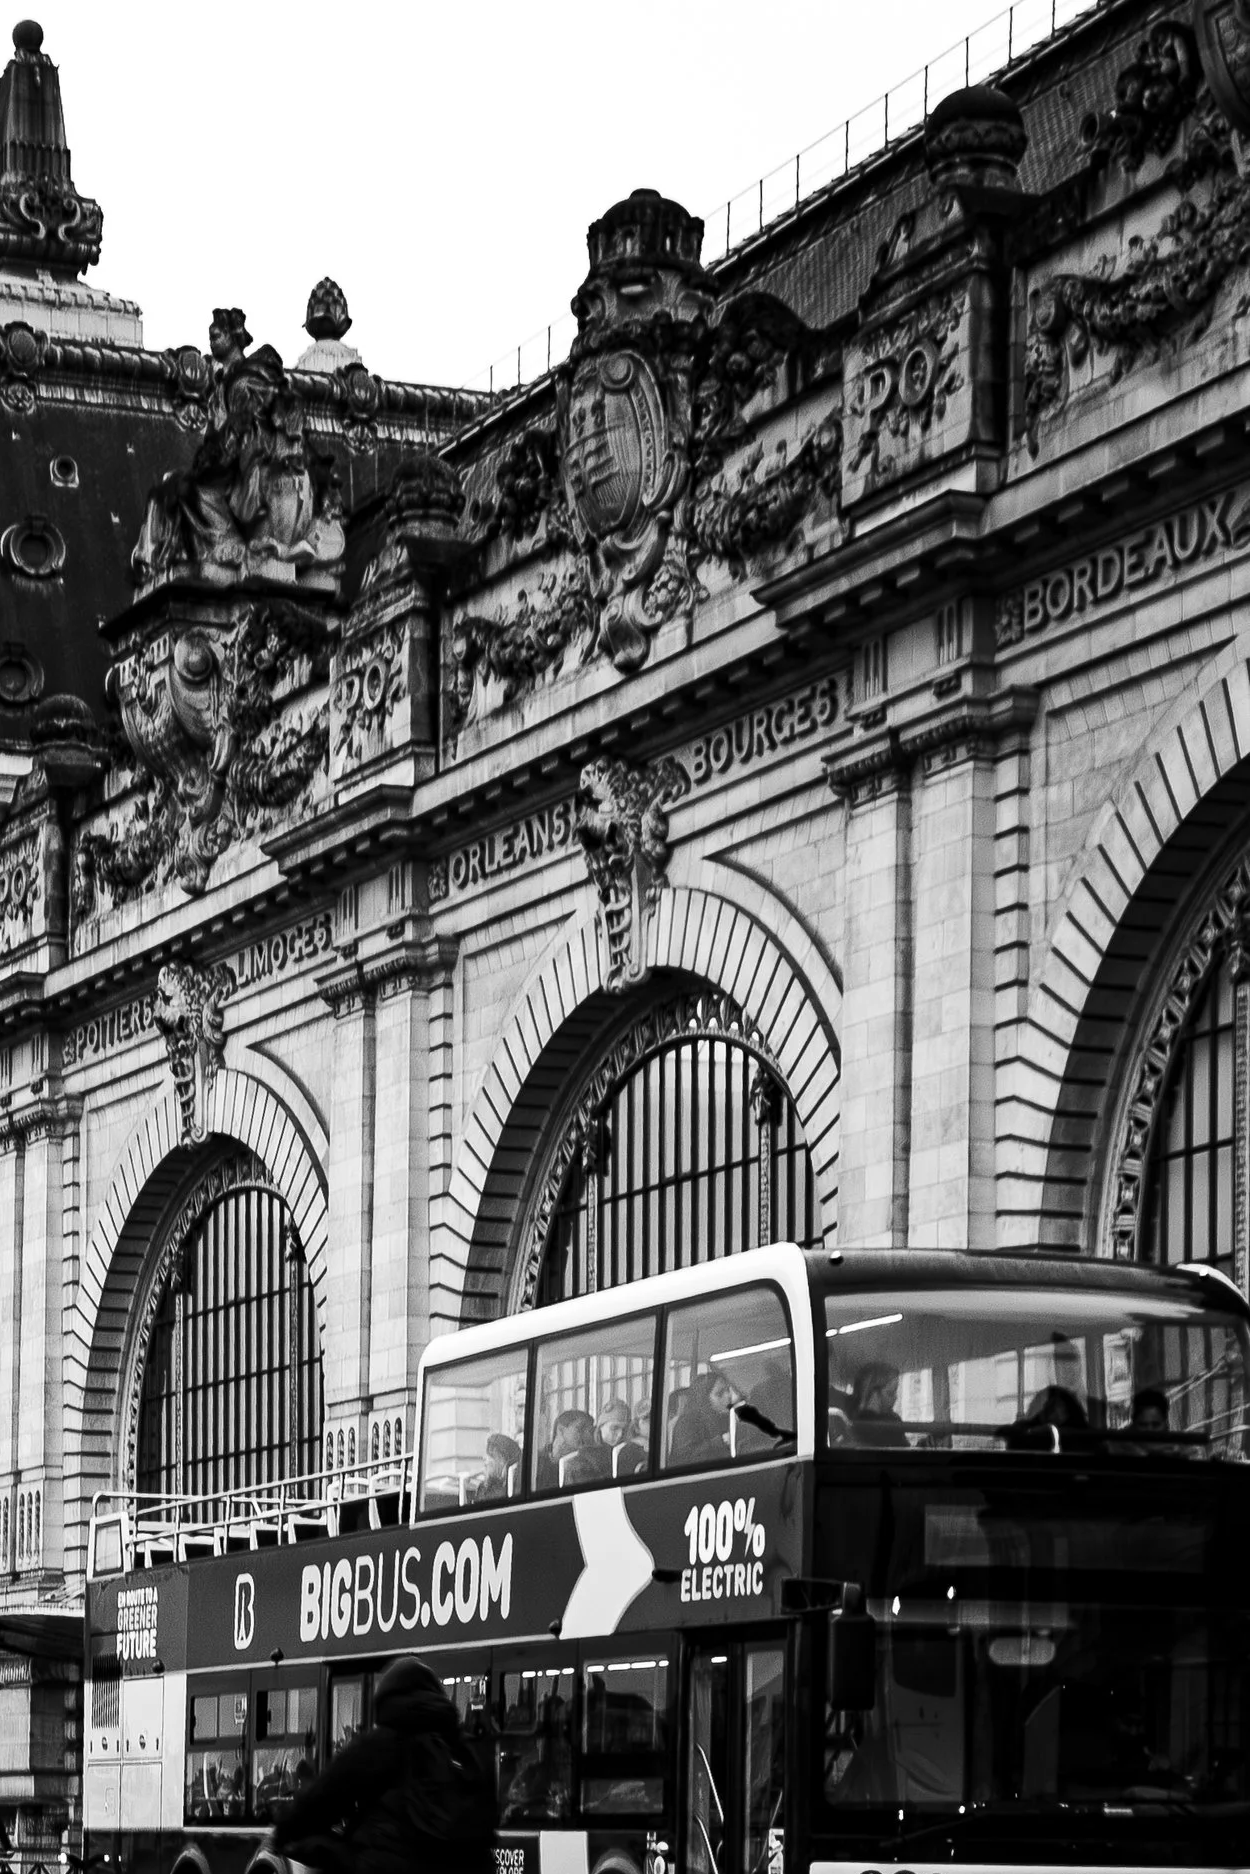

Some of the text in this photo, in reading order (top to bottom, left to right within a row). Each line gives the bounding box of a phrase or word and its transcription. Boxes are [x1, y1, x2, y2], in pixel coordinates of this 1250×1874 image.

[1023, 492, 1234, 635] BORDEAUX
[692, 678, 844, 786] BOURGES
[451, 803, 574, 891] ORLEANS
[236, 912, 333, 988] LIMOGES
[74, 997, 156, 1060] POITIERS
[684, 1497, 766, 1566] 100%
[300, 1533, 513, 1642] BIGBUS.COM
[680, 1561, 764, 1602] ELECTRIC
[116, 1628, 158, 1661] FUTURE
[117, 1604, 158, 1631] GREENER
[494, 1848, 524, 1866] SCOVER
